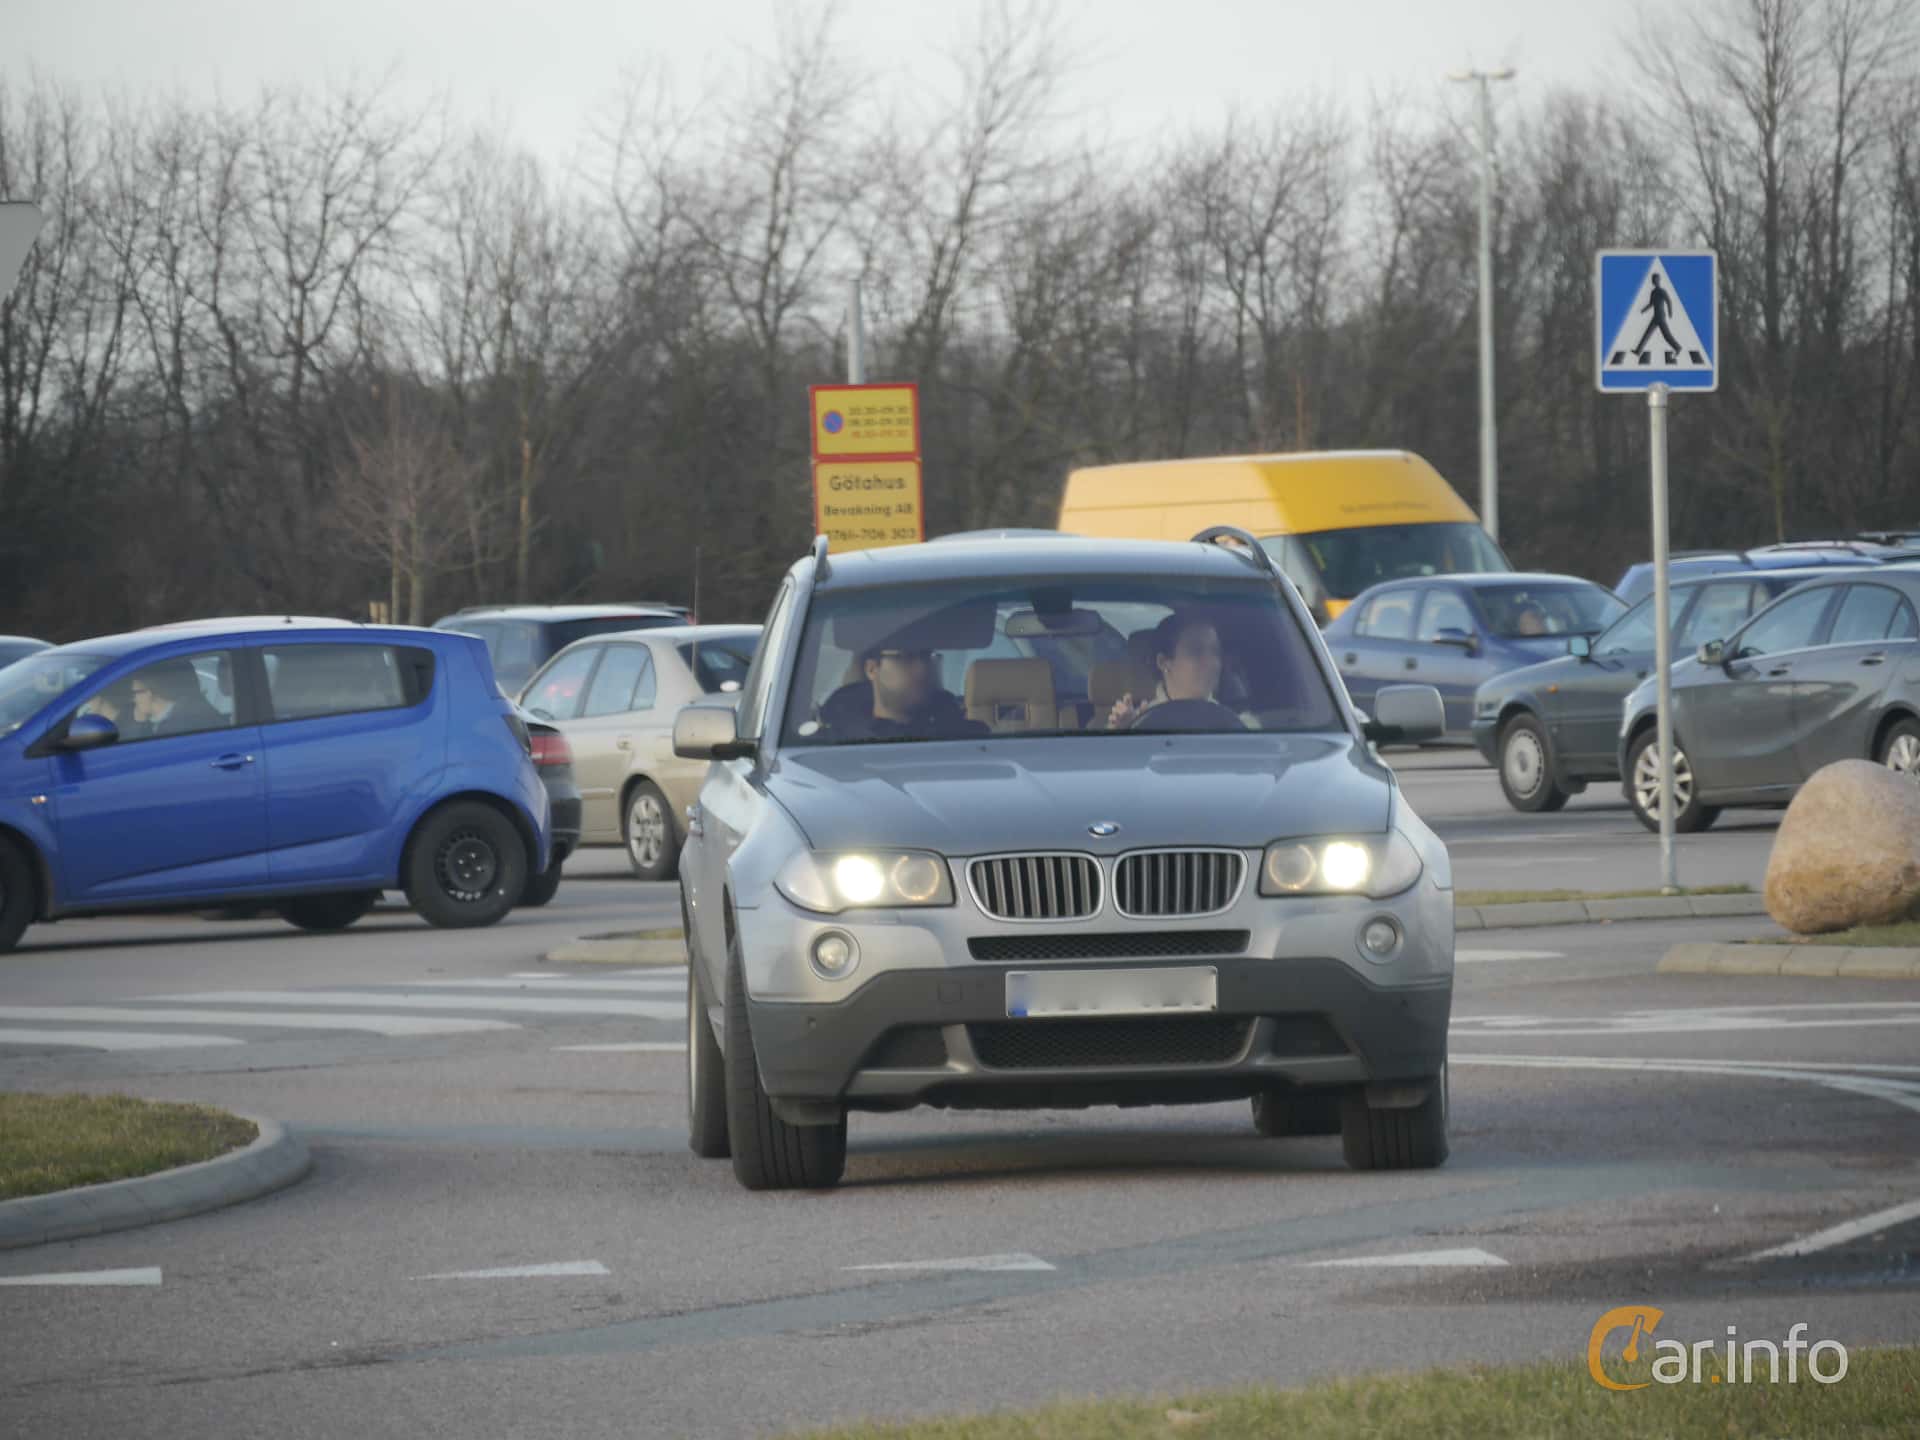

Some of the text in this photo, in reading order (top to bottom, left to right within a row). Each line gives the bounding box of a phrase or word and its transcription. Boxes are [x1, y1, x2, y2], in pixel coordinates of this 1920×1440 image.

[830, 475, 905, 491] Götahus
[824, 502, 912, 517] Bevakning AB
